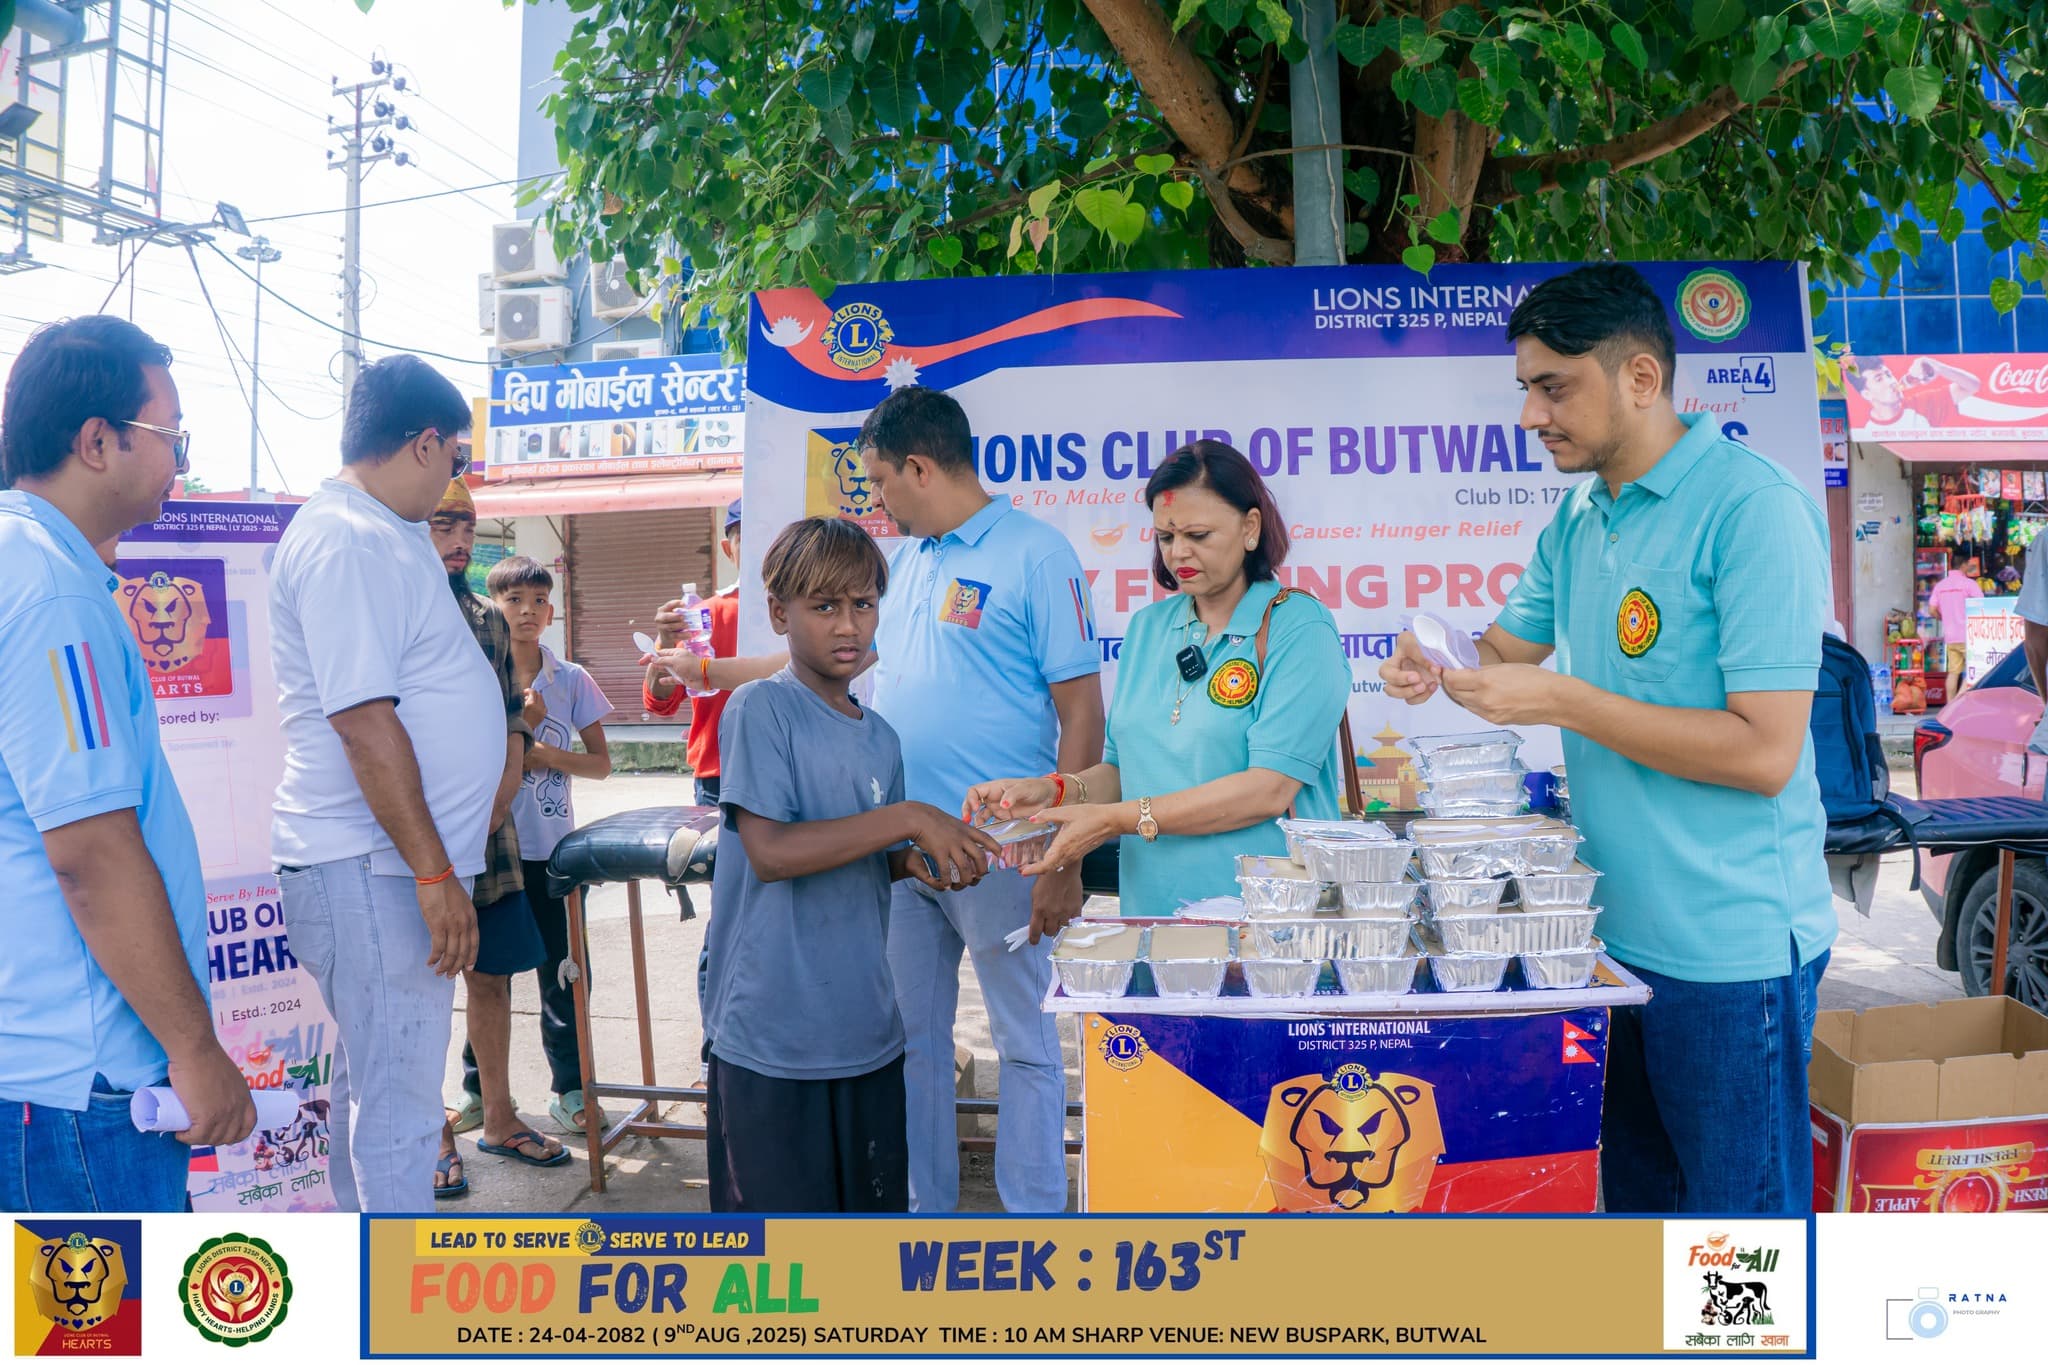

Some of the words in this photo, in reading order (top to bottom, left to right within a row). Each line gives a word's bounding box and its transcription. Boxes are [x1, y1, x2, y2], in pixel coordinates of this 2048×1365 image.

[1313, 286, 1402, 311] LIONS
[1410, 284, 1537, 310] INTERNA
[837, 304, 880, 320] LIONS
[1314, 313, 1394, 330] DISTRICT
[1398, 312, 1430, 328] 325
[1434, 312, 1447, 329] P,
[1451, 311, 1508, 327] NEPAL
[850, 323, 868, 348] L
[503, 371, 550, 416] दिप
[555, 365, 655, 413] मोबाईल
[661, 361, 740, 407] सेन्टर
[1249, 426, 1314, 477] OF
[1328, 423, 1543, 475] BUTWAL
[1031, 489, 1058, 506] To
[1064, 488, 1127, 506] Make
[1455, 487, 1501, 506] Club
[1508, 487, 1535, 505] ID:
[153, 523, 185, 531] DISTRICT
[206, 524, 228, 532] NEPAL
[190, 513, 279, 525] INTERNATIONAL
[1289, 523, 1363, 541] Cause:
[1370, 522, 1452, 542] Hunger
[1457, 520, 1524, 538] Relief
[200, 710, 220, 725] by:
[206, 892, 235, 904] Serve
[238, 888, 253, 901] By
[206, 905, 248, 938] UB
[269, 998, 302, 1015] 2024
[1108, 1025, 1139, 1037] LIONS
[1288, 1022, 1326, 1037] LIONS
[1330, 1020, 1432, 1037] INTERNATIONAL
[1117, 1038, 1132, 1055] L
[1298, 1039, 1345, 1051] DISTRICT
[1349, 1039, 1367, 1050] 325
[1379, 1038, 1414, 1049] NEPAL
[240, 1058, 286, 1091] ood
[1339, 1063, 1366, 1074] LIONS
[1347, 1075, 1359, 1090] L
[1926, 1150, 1970, 1166] FRUIT
[1974, 1148, 2020, 1165] FRESH
[237, 1180, 284, 1207] सबैका
[290, 1169, 327, 1193] लागि
[1874, 1196, 1921, 1213] APPLE
